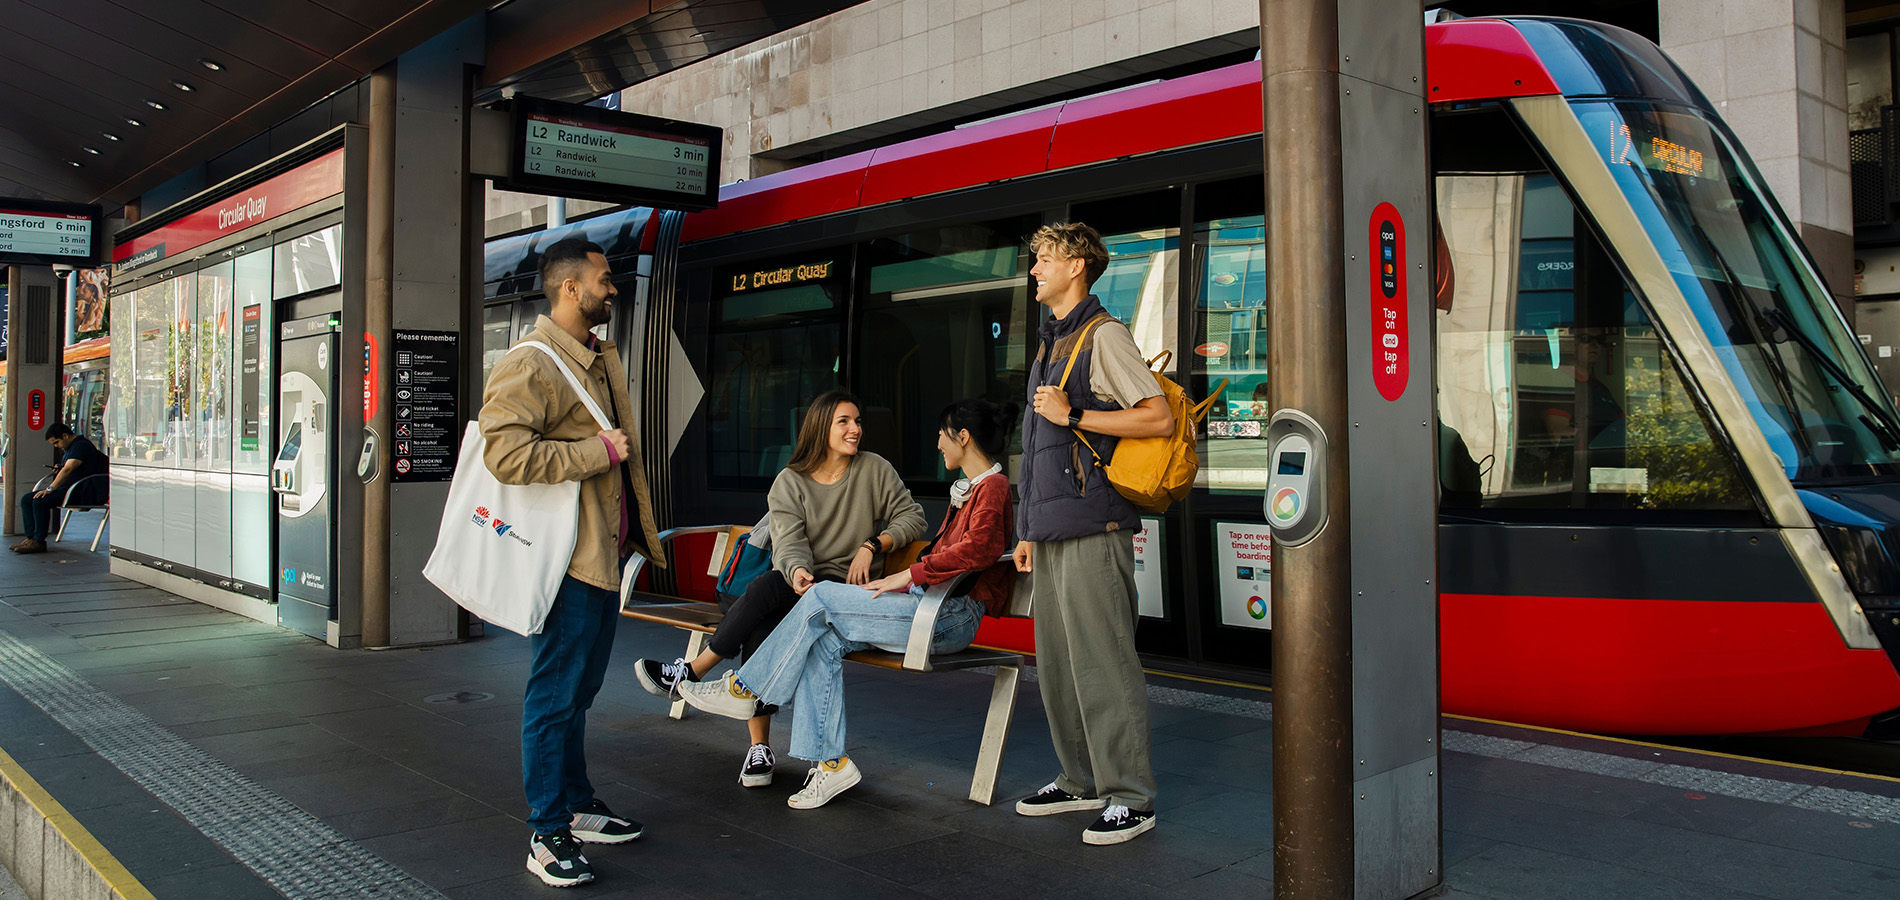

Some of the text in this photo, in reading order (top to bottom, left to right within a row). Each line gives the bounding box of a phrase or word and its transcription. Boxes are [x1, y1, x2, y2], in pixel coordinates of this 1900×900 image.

[533, 126, 616, 149] L2 Randwick
[531, 146, 597, 163] L2 Randwick
[673, 147, 704, 161] 3 min
[1652, 137, 1703, 172] CIRCULAR
[530, 162, 596, 178] L2 Randwick
[677, 167, 703, 177] 10 min
[676, 182, 702, 192] 22 min
[218, 196, 267, 229] Circular Quay
[56, 222, 62, 230] 6
[66, 223, 86, 232] min
[1382, 232, 1394, 241] opal
[733, 264, 828, 291] L2 Circular Quay
[1383, 308, 1396, 320] Tap
[1385, 321, 1395, 329] on
[1385, 337, 1396, 345] and
[1385, 351, 1397, 362] tap
[1386, 364, 1396, 374] off
[472, 514, 487, 525] NSW
[1229, 531, 1242, 540] Tap
[1232, 541, 1248, 549] time
[1236, 551, 1271, 563] boarding
[281, 567, 296, 584] opal
